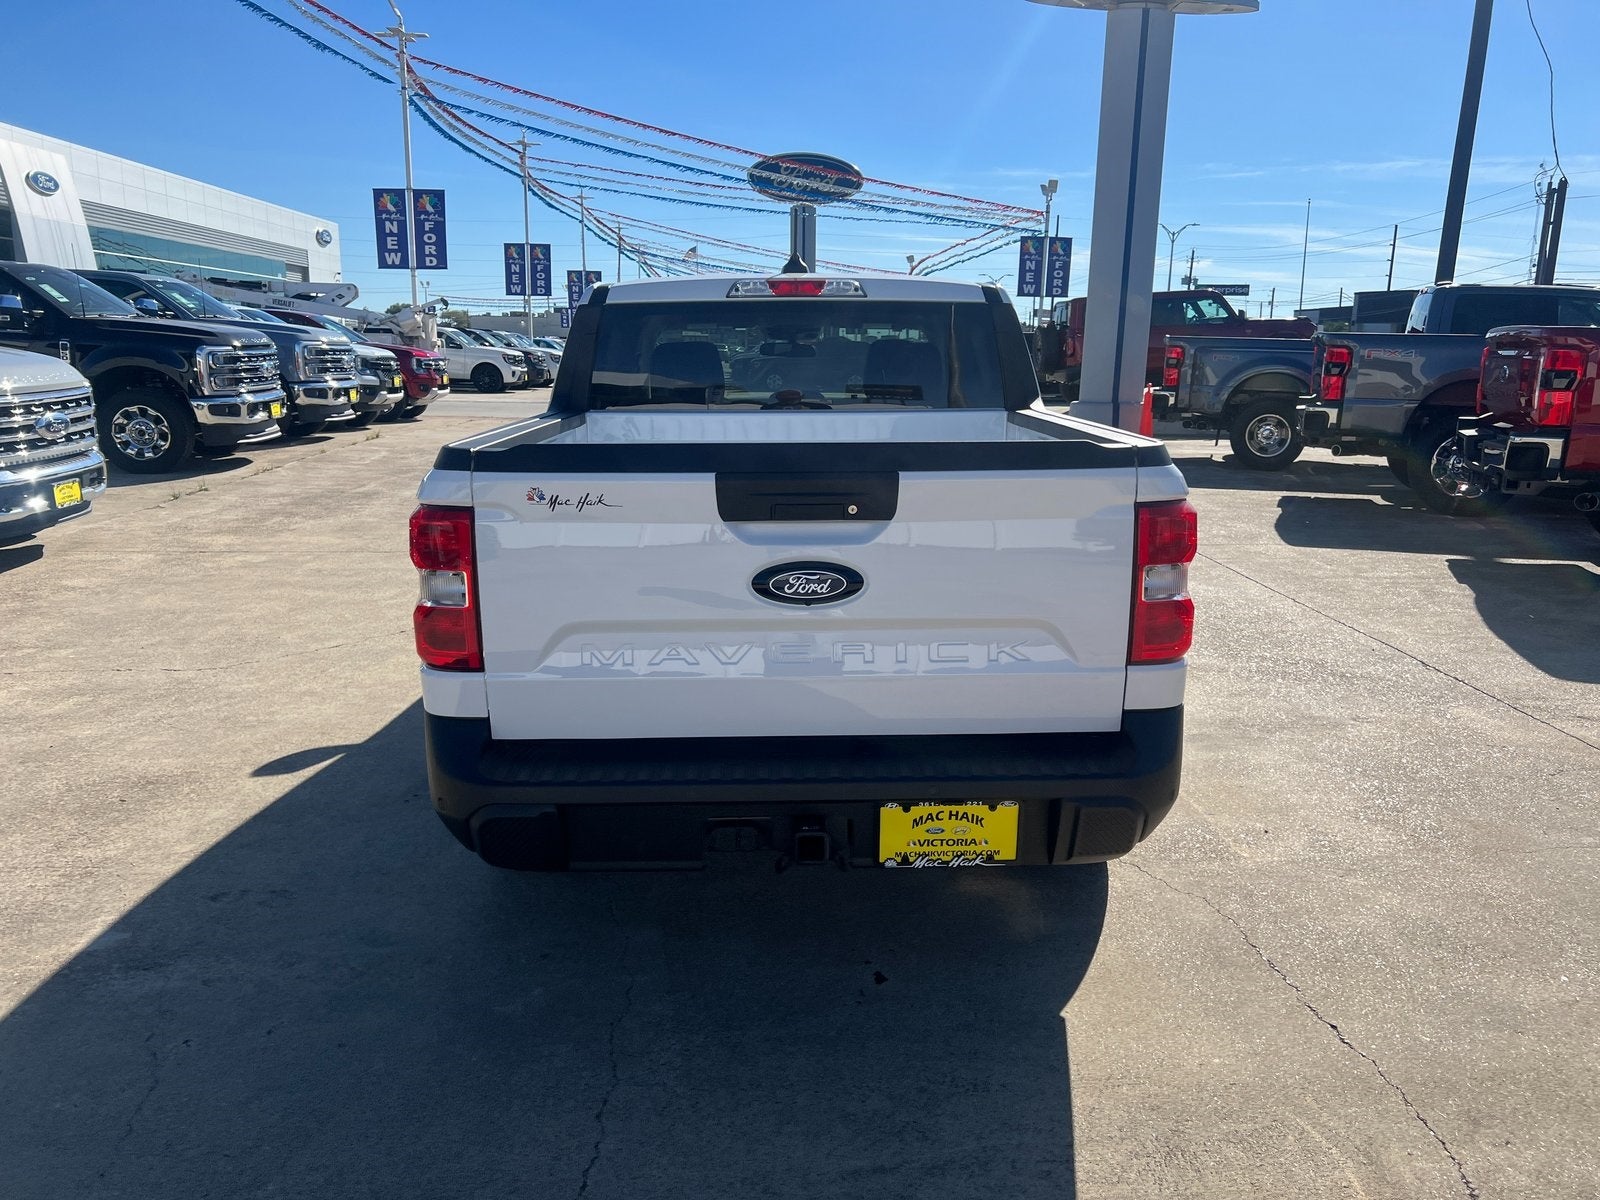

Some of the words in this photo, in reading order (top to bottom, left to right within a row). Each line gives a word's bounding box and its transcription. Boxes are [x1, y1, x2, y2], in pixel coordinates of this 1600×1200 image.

[37, 174, 55, 190] Ford
[384, 220, 402, 266] NEW
[423, 221, 438, 268] FORD
[510, 264, 522, 294] NEW
[536, 264, 546, 295] FORD
[1022, 260, 1036, 294] NEW
[1052, 261, 1064, 295] FORD
[1364, 349, 1419, 360] FX4
[546, 494, 576, 512] Mac
[575, 492, 623, 513] Haik
[784, 574, 832, 594] Ford
[579, 641, 1030, 668] MAVERICK
[911, 811, 945, 830] MAC
[948, 810, 985, 828] HAIK
[918, 838, 978, 847] VICTORIA
[911, 856, 947, 868] Mac
[948, 855, 1006, 868] Haik
